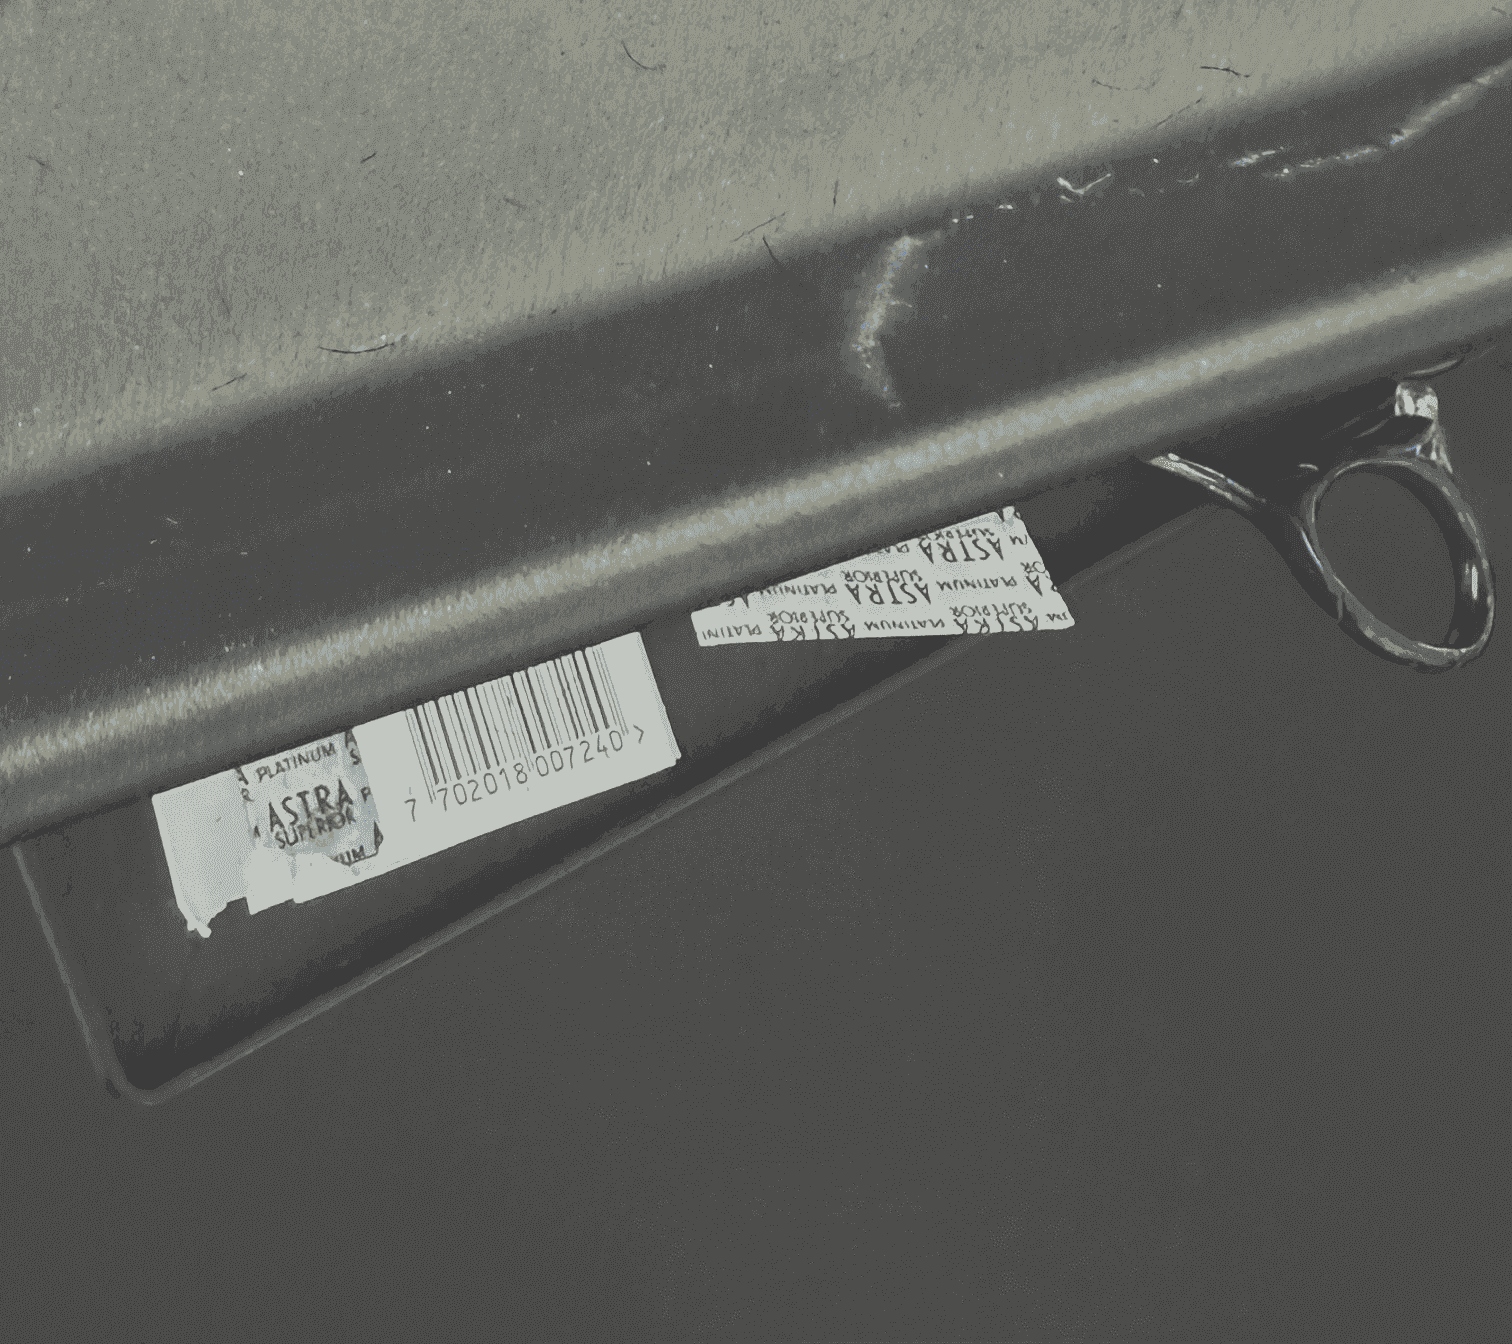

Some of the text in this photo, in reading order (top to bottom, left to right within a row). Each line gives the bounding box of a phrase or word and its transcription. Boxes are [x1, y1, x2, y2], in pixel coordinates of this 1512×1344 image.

[918, 536, 1005, 565] ASTRA
[845, 581, 932, 606] ASTRA
[936, 575, 1018, 592] PLATINUM
[863, 618, 946, 632] PLATINUM
[255, 742, 337, 784] PLATINUM
[268, 777, 355, 834] ASTRA
